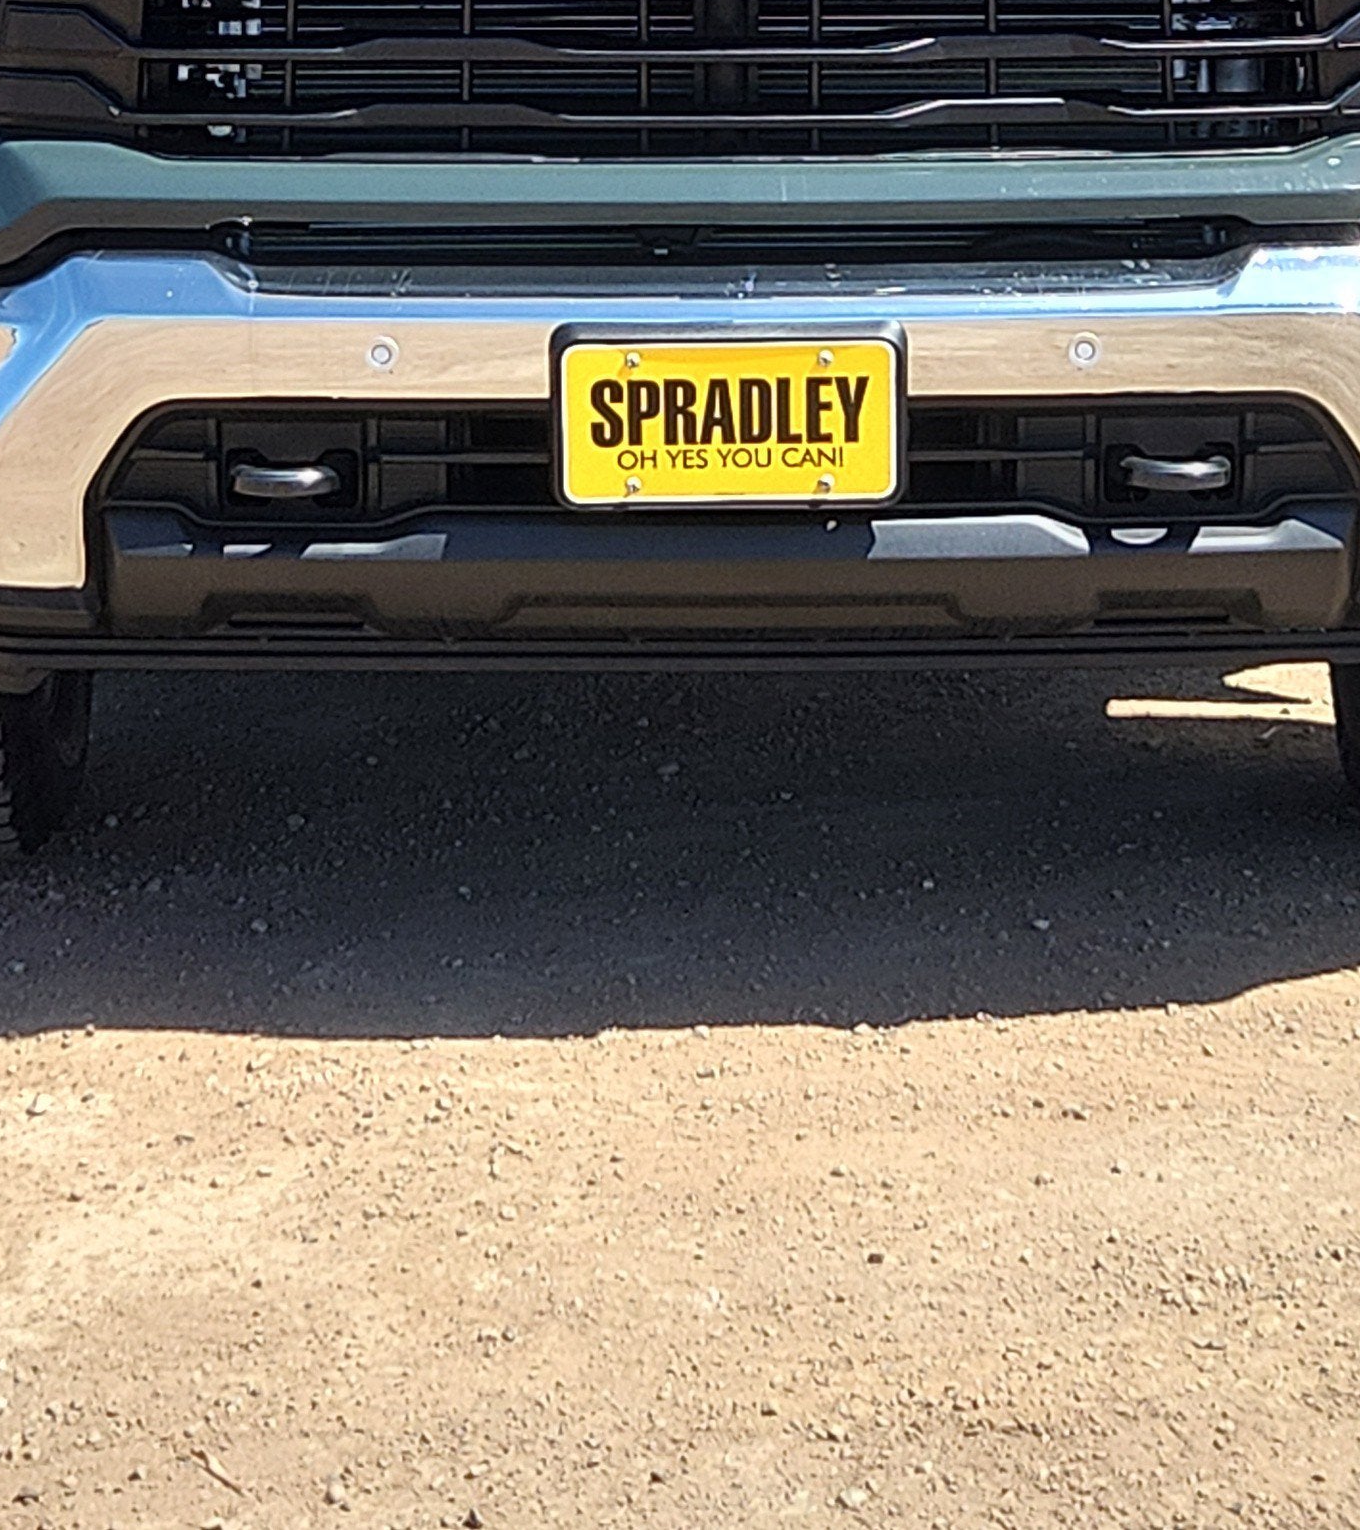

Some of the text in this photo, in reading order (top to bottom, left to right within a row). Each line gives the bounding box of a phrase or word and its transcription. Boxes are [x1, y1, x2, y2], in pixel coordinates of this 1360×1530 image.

[590, 375, 869, 448] SPRADLEY
[617, 446, 844, 471] OH YES YOU CAN!
